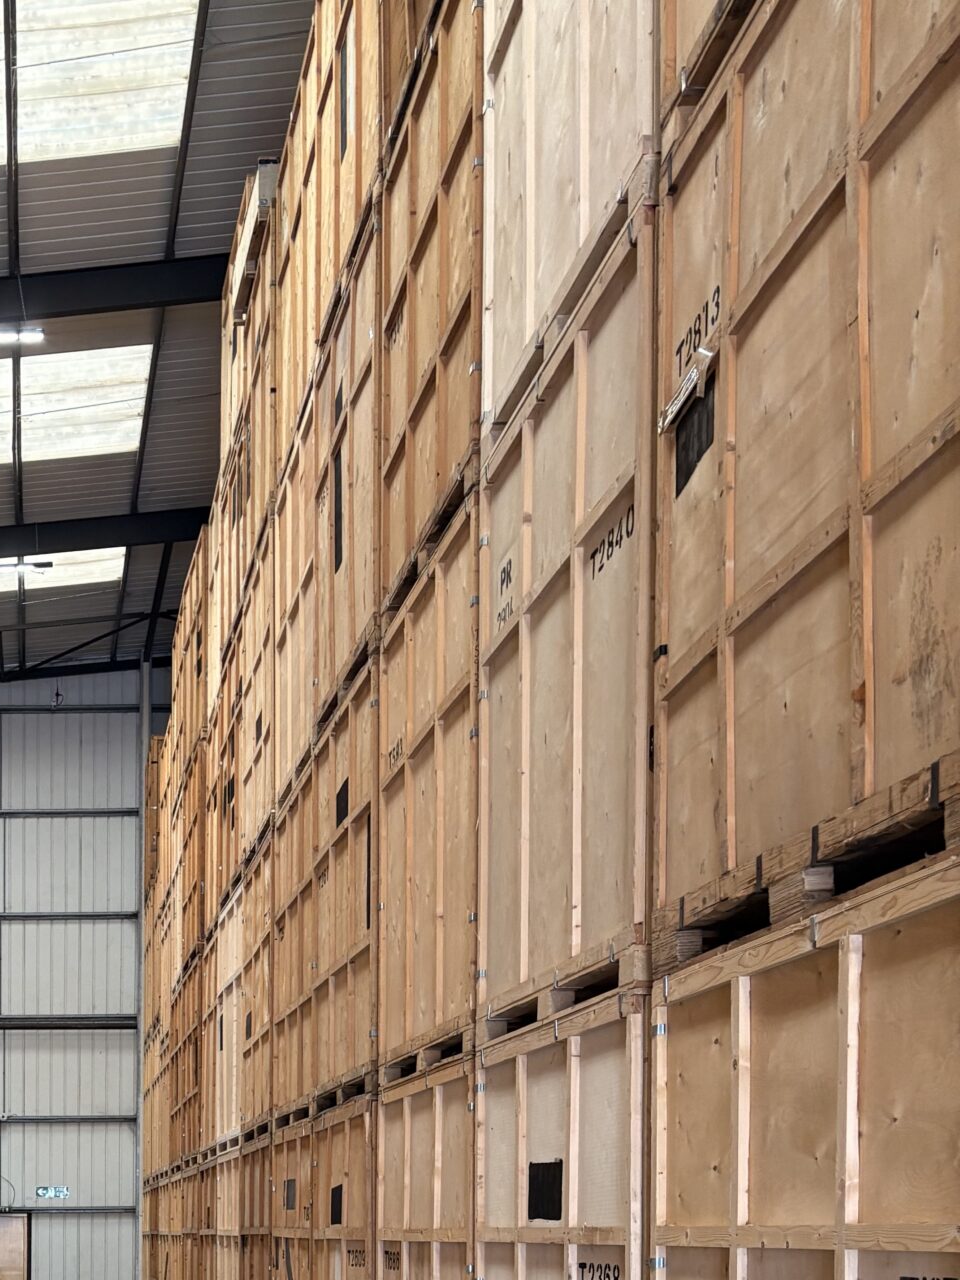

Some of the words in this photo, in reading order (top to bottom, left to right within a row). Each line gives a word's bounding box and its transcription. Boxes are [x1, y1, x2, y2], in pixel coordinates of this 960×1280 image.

[676, 284, 720, 377] T2813
[500, 558, 512, 596] PR
[590, 503, 635, 581] T2840
